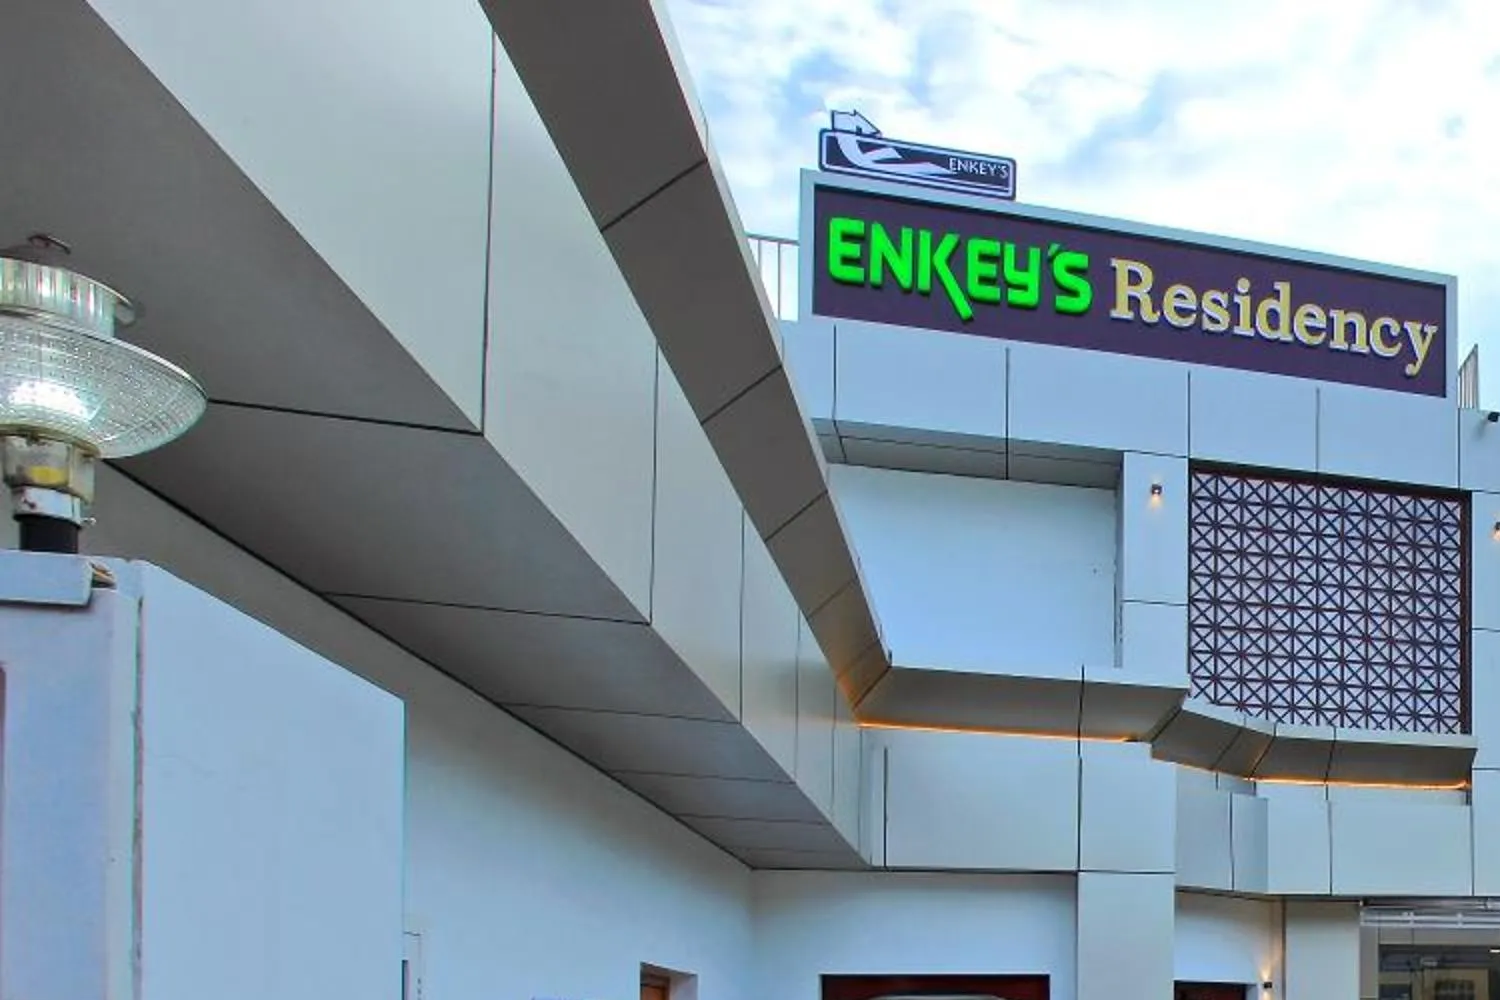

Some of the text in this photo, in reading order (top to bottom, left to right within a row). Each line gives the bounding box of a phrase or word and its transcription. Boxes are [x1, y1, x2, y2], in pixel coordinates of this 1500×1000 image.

[949, 157, 1009, 179] ENKEY'S
[828, 217, 1438, 377] ENKEY'S Residency
